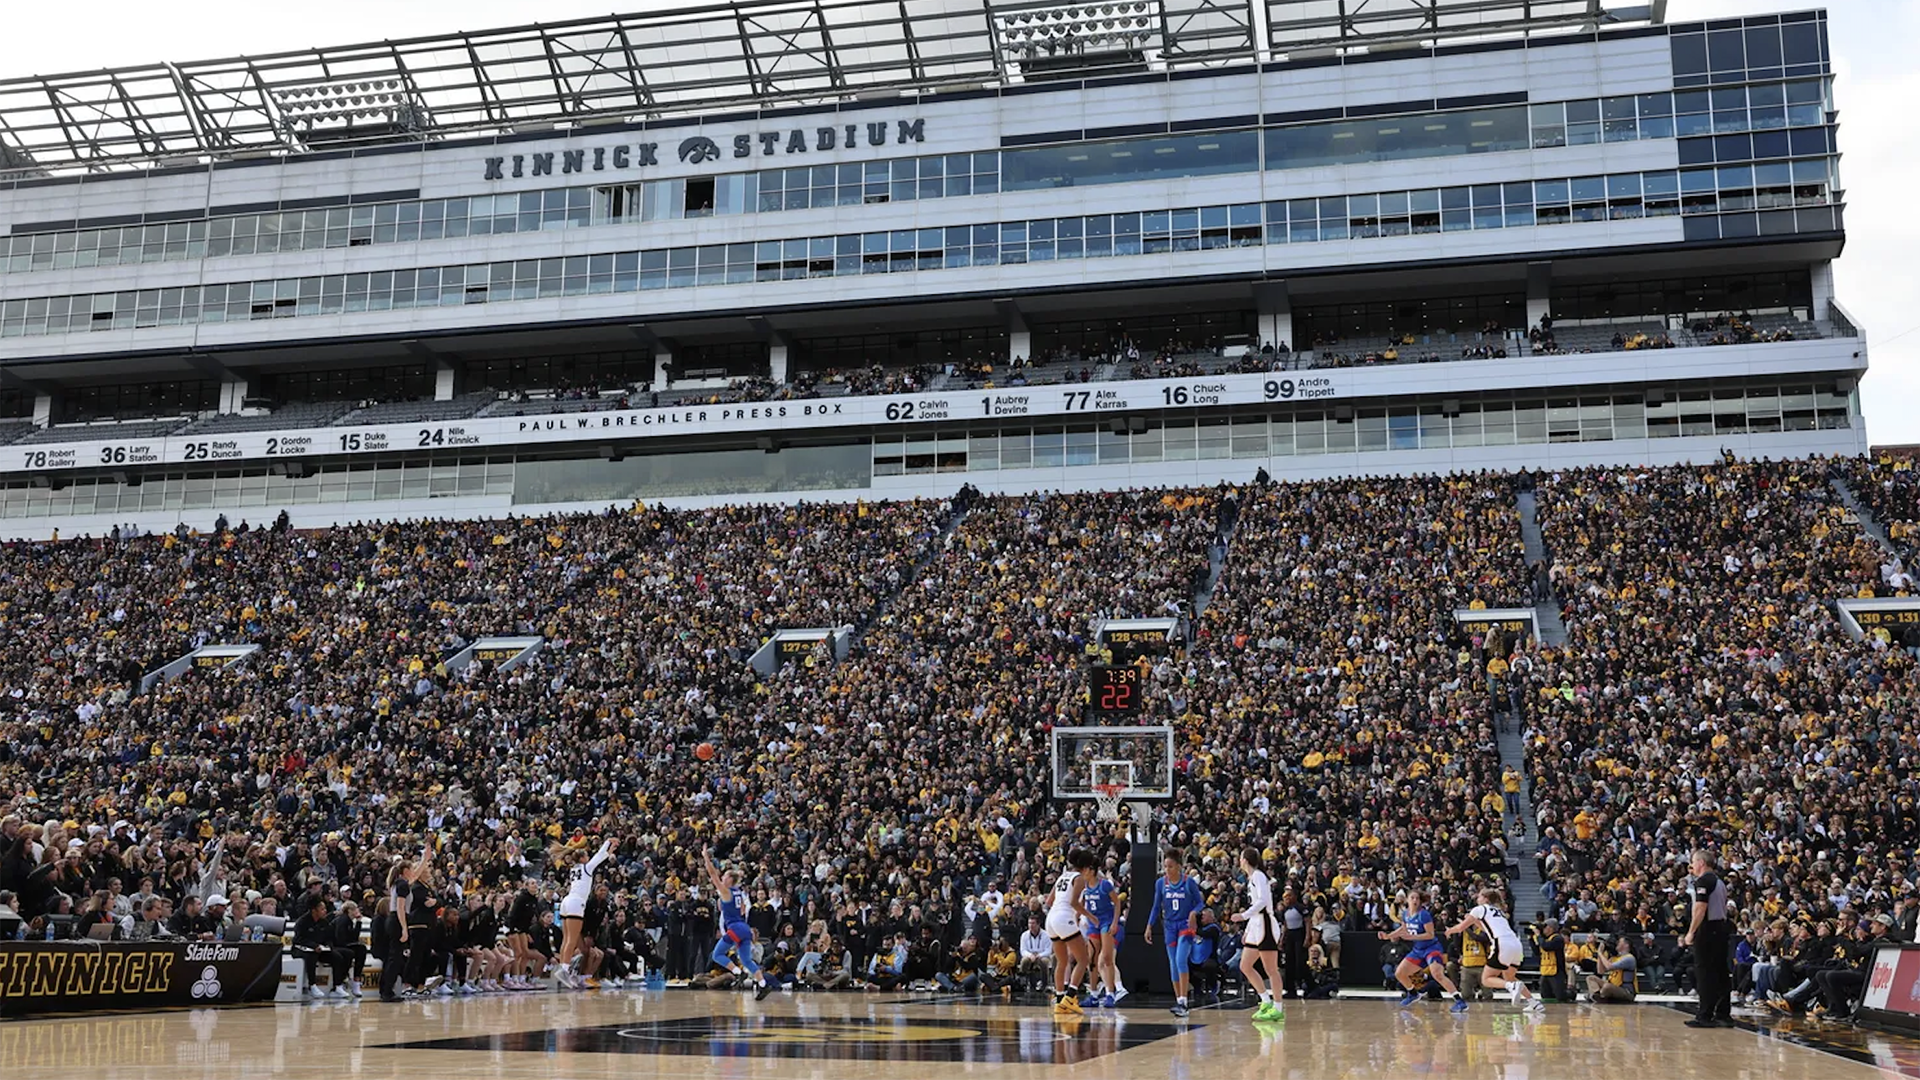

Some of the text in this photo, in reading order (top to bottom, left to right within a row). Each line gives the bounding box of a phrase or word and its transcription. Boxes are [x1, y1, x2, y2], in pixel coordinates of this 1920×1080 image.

[484, 118, 926, 180] KINNICK STADIUM
[1193, 383, 1226, 394] Chuck
[1298, 377, 1330, 388] Andre
[1095, 389, 1117, 399] Alex
[1264, 379, 1295, 399] 99
[1298, 386, 1335, 399] Tippett
[994, 394, 1029, 406] Aubrey
[1063, 392, 1091, 411] 77
[1162, 386, 1188, 405] 16
[1193, 393, 1219, 405] Long
[919, 400, 948, 411] Calvin
[981, 396, 991, 415] 1
[994, 404, 1028, 415] Devine
[1095, 398, 1127, 409] Karras
[519, 403, 843, 431] PAUL W. BRECHLER PRESS BOX
[885, 402, 914, 421] 62
[918, 409, 948, 420] Jones
[364, 431, 386, 442] Duke
[448, 427, 465, 436] Nile
[281, 436, 312, 446] Gordon
[339, 433, 361, 451] 15
[418, 429, 444, 447] 24
[448, 434, 480, 445] Kinnick
[129, 445, 150, 455] Larry
[212, 440, 238, 451] Randy
[266, 438, 278, 455] 2
[280, 444, 306, 455] Locke
[363, 440, 389, 450] Slater
[48, 449, 75, 460] Robert
[101, 446, 126, 463] 36
[129, 452, 157, 463] Station
[184, 443, 208, 460] 25
[211, 448, 242, 459] Duncan
[24, 451, 46, 468] 78
[48, 458, 75, 469] Gallery
[1857, 611, 1919, 624] 130 131
[782, 642, 801, 653] 127
[1106, 669, 1136, 684] 7:39
[1101, 684, 1131, 709] 22
[1056, 878, 1070, 892] 45
[1172, 899, 1179, 911] 0
[0, 952, 174, 998] INNICK
